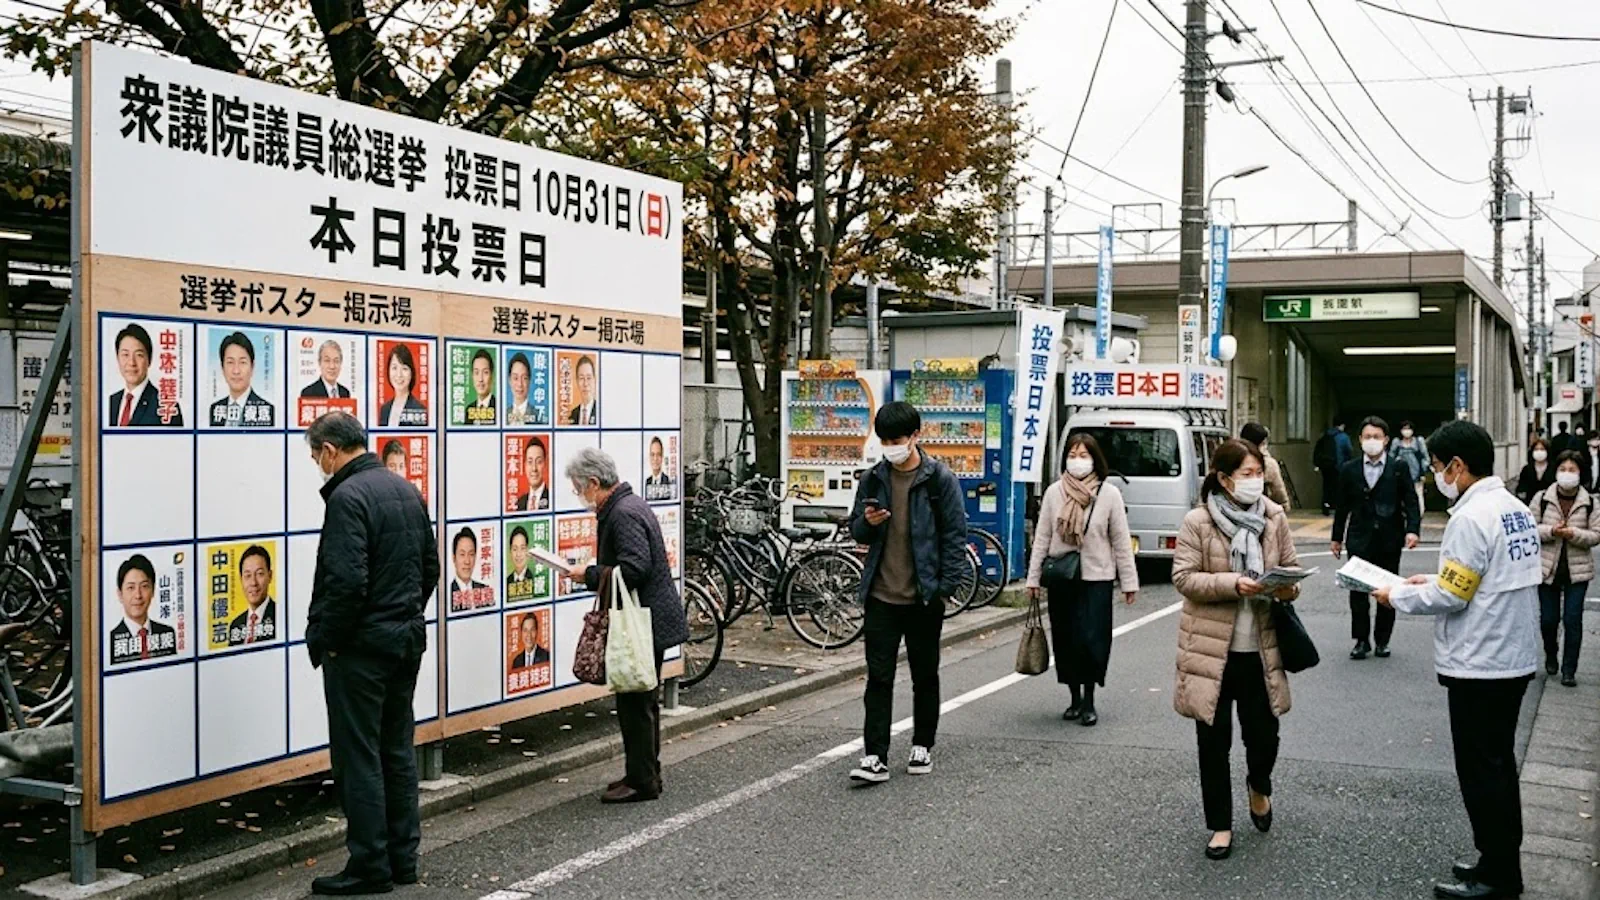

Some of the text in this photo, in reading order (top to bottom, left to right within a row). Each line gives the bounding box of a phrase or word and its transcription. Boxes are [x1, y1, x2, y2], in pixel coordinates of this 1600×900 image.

[119, 73, 427, 193] 衆議院議員総選挙
[445, 148, 521, 212] 投票日
[309, 196, 546, 289] 本日投票日
[179, 274, 413, 328] 選挙ポスター掲示場
[492, 306, 645, 346] 選挙ポスター掲示場
[1279, 300, 1302, 313] JR
[1020, 324, 1053, 471] 投票日本日
[1072, 371, 1180, 397] 投票日本日
